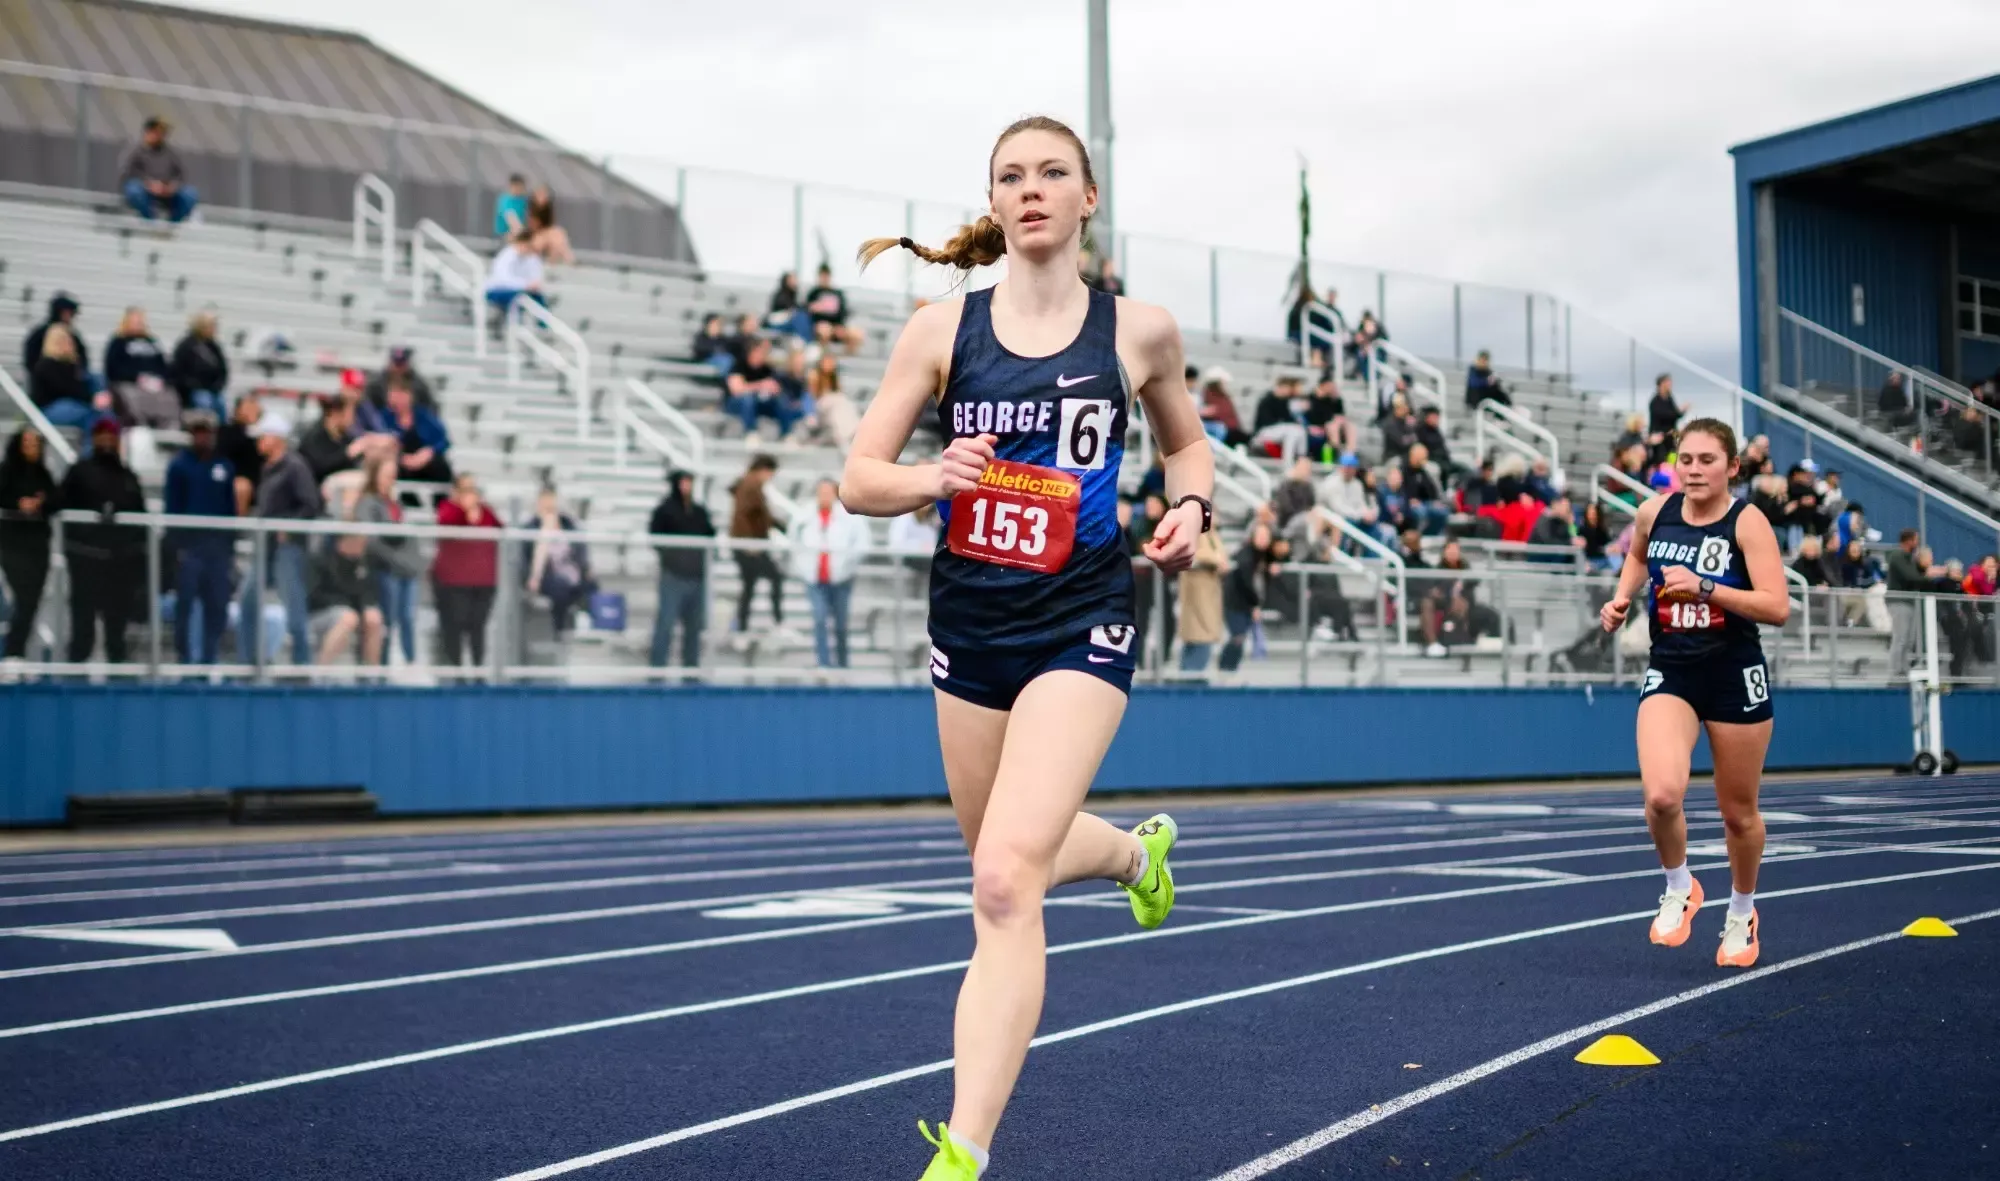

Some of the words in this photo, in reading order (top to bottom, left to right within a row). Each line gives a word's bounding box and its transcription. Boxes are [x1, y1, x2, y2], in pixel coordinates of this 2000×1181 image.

[953, 401, 1053, 433] GEORGE
[1070, 404, 1100, 465] 6
[1045, 483, 1071, 495] NET
[968, 498, 1048, 556] 153
[1703, 542, 1722, 572] 8
[1670, 602, 1711, 628] 163
[1749, 669, 1764, 699] 8
